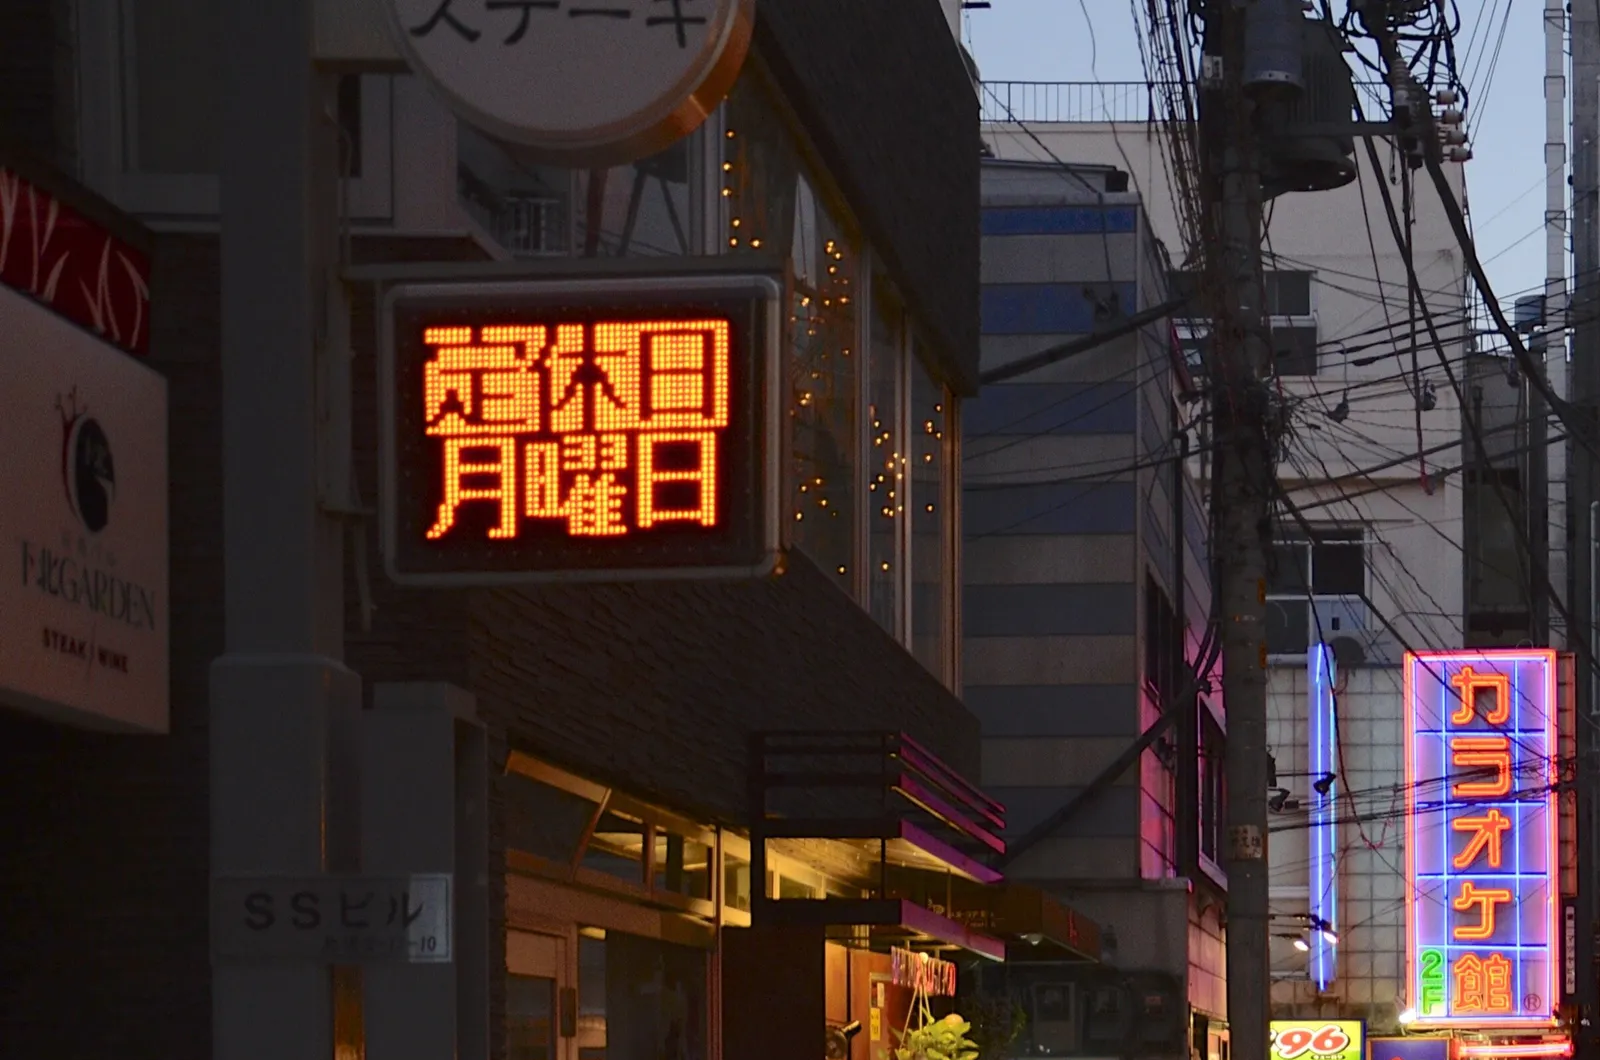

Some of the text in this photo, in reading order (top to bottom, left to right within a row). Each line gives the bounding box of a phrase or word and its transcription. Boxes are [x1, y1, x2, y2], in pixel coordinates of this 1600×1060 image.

[424, 319, 730, 436] 定休日
[425, 431, 719, 540] 月曜日
[1451, 665, 1512, 1012] カラオケ館
[1420, 949, 1446, 1015] 2F
